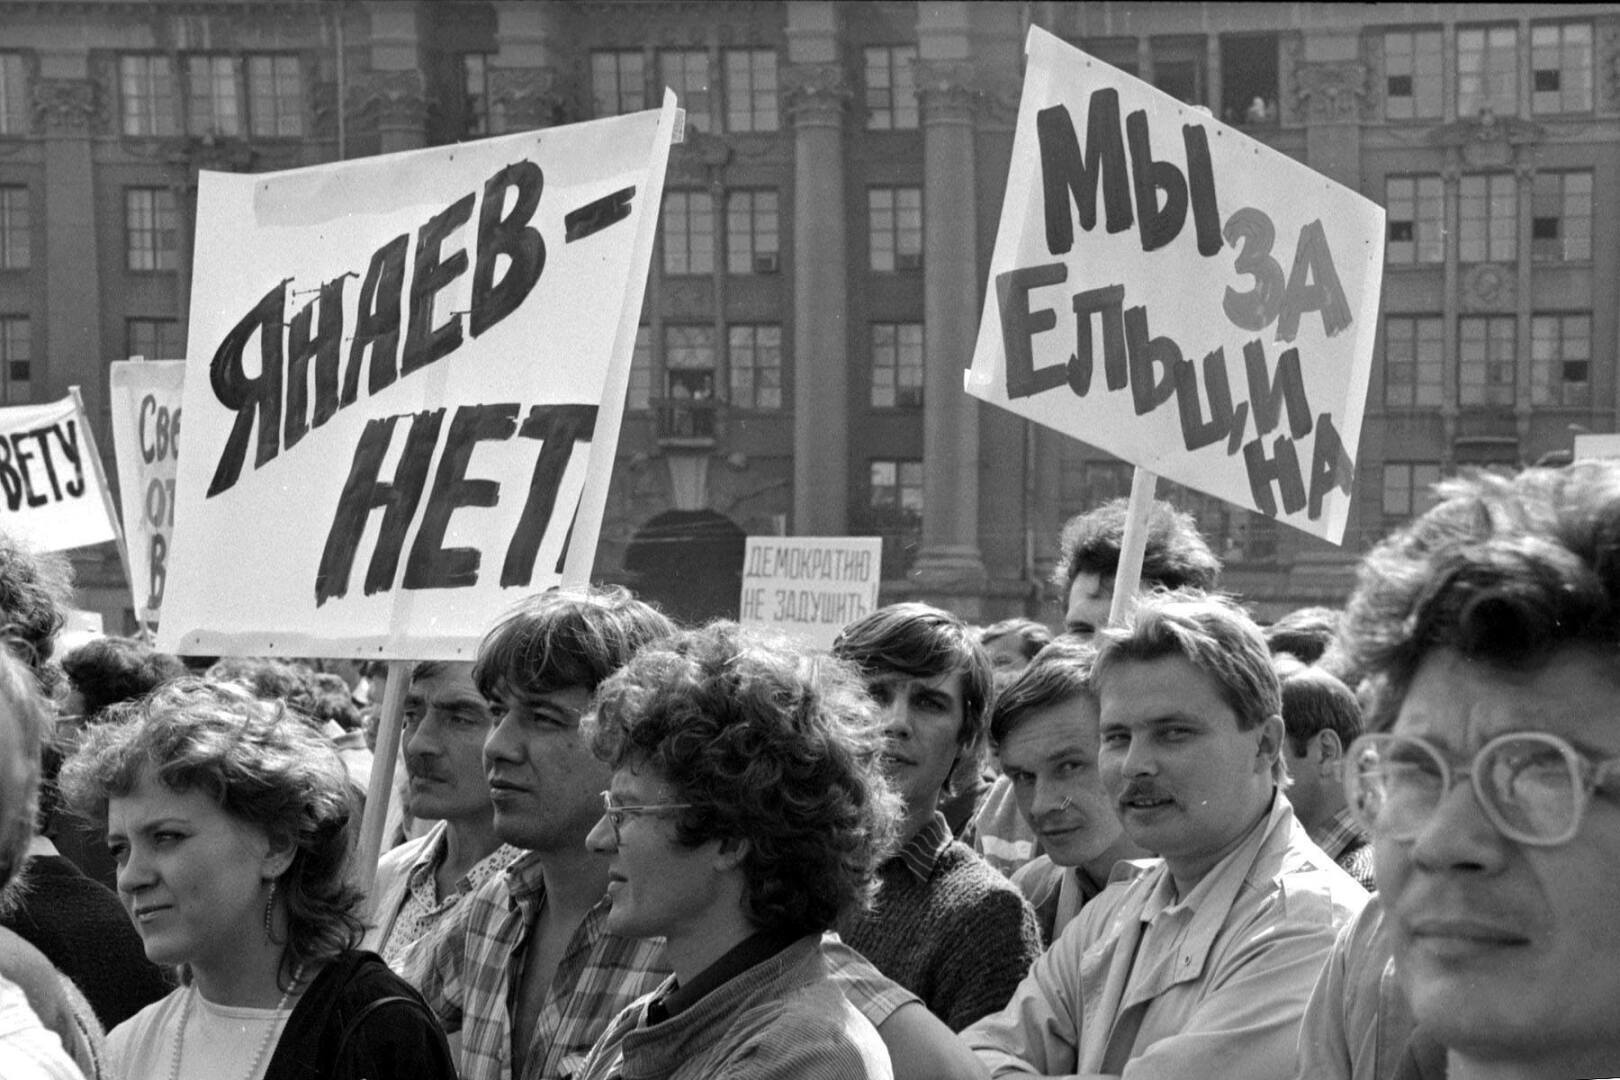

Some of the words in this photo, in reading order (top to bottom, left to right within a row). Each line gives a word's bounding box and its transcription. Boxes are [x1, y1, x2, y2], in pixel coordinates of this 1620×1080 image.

[1037, 88, 1223, 257] МЫ
[1222, 206, 1353, 343] ЗА
[743, 588, 766, 621] НЕ
[747, 546, 871, 582] ДЕМОКРАТИЮ
